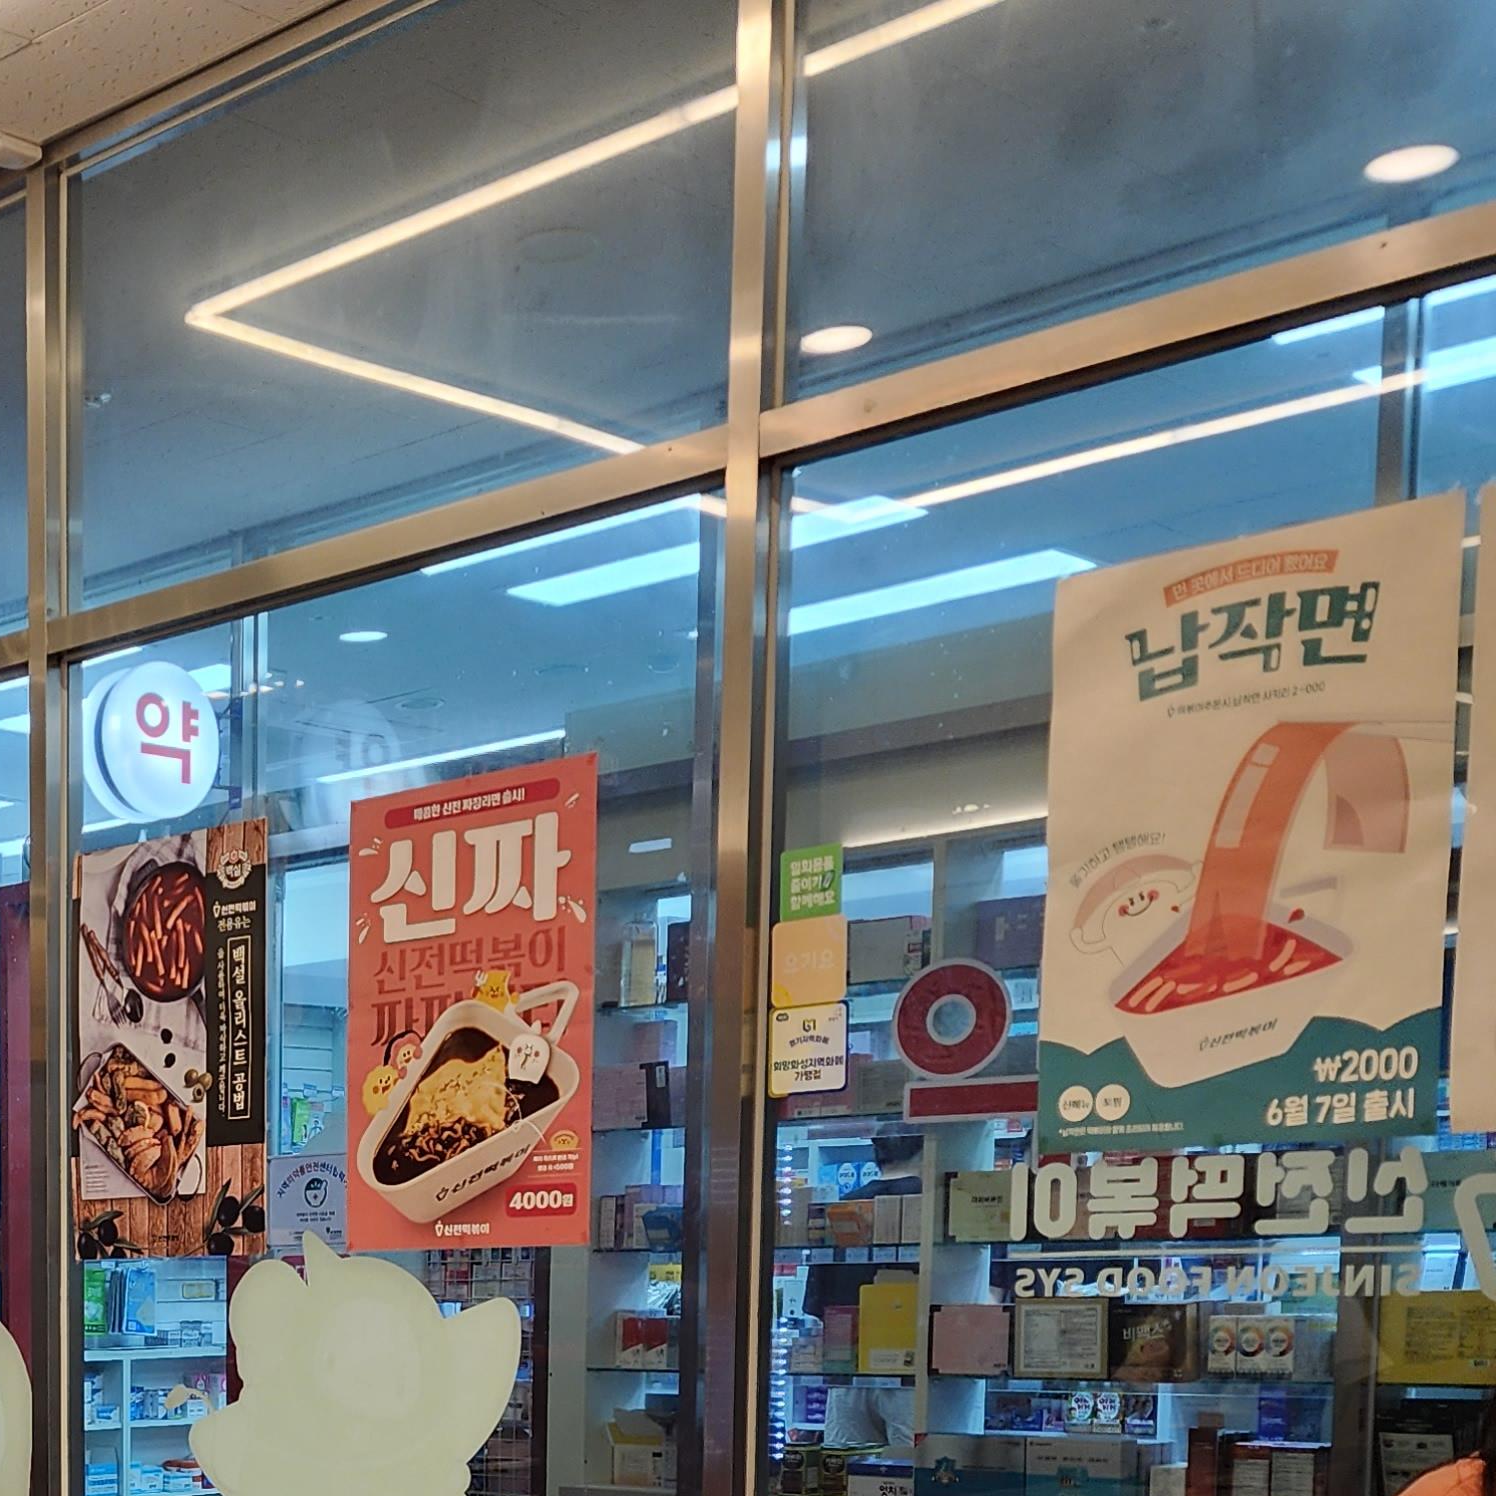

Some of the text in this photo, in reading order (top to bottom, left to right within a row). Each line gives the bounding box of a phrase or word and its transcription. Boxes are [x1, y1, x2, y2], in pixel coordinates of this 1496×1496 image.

[1125, 581, 1381, 702] 납작면
[135, 692, 199, 785] 약
[370, 811, 572, 944] 신짜
[232, 945, 246, 985] 백설
[374, 926, 566, 995] 신전떡볶이
[232, 989, 248, 1066] 올리스트
[1313, 1046, 1419, 1083] ₩2000
[1266, 1087, 1415, 1127] 6월 7일 출시
[509, 1190, 573, 1210] 4000원
[444, 1222, 490, 1237] 신전떡볶이
